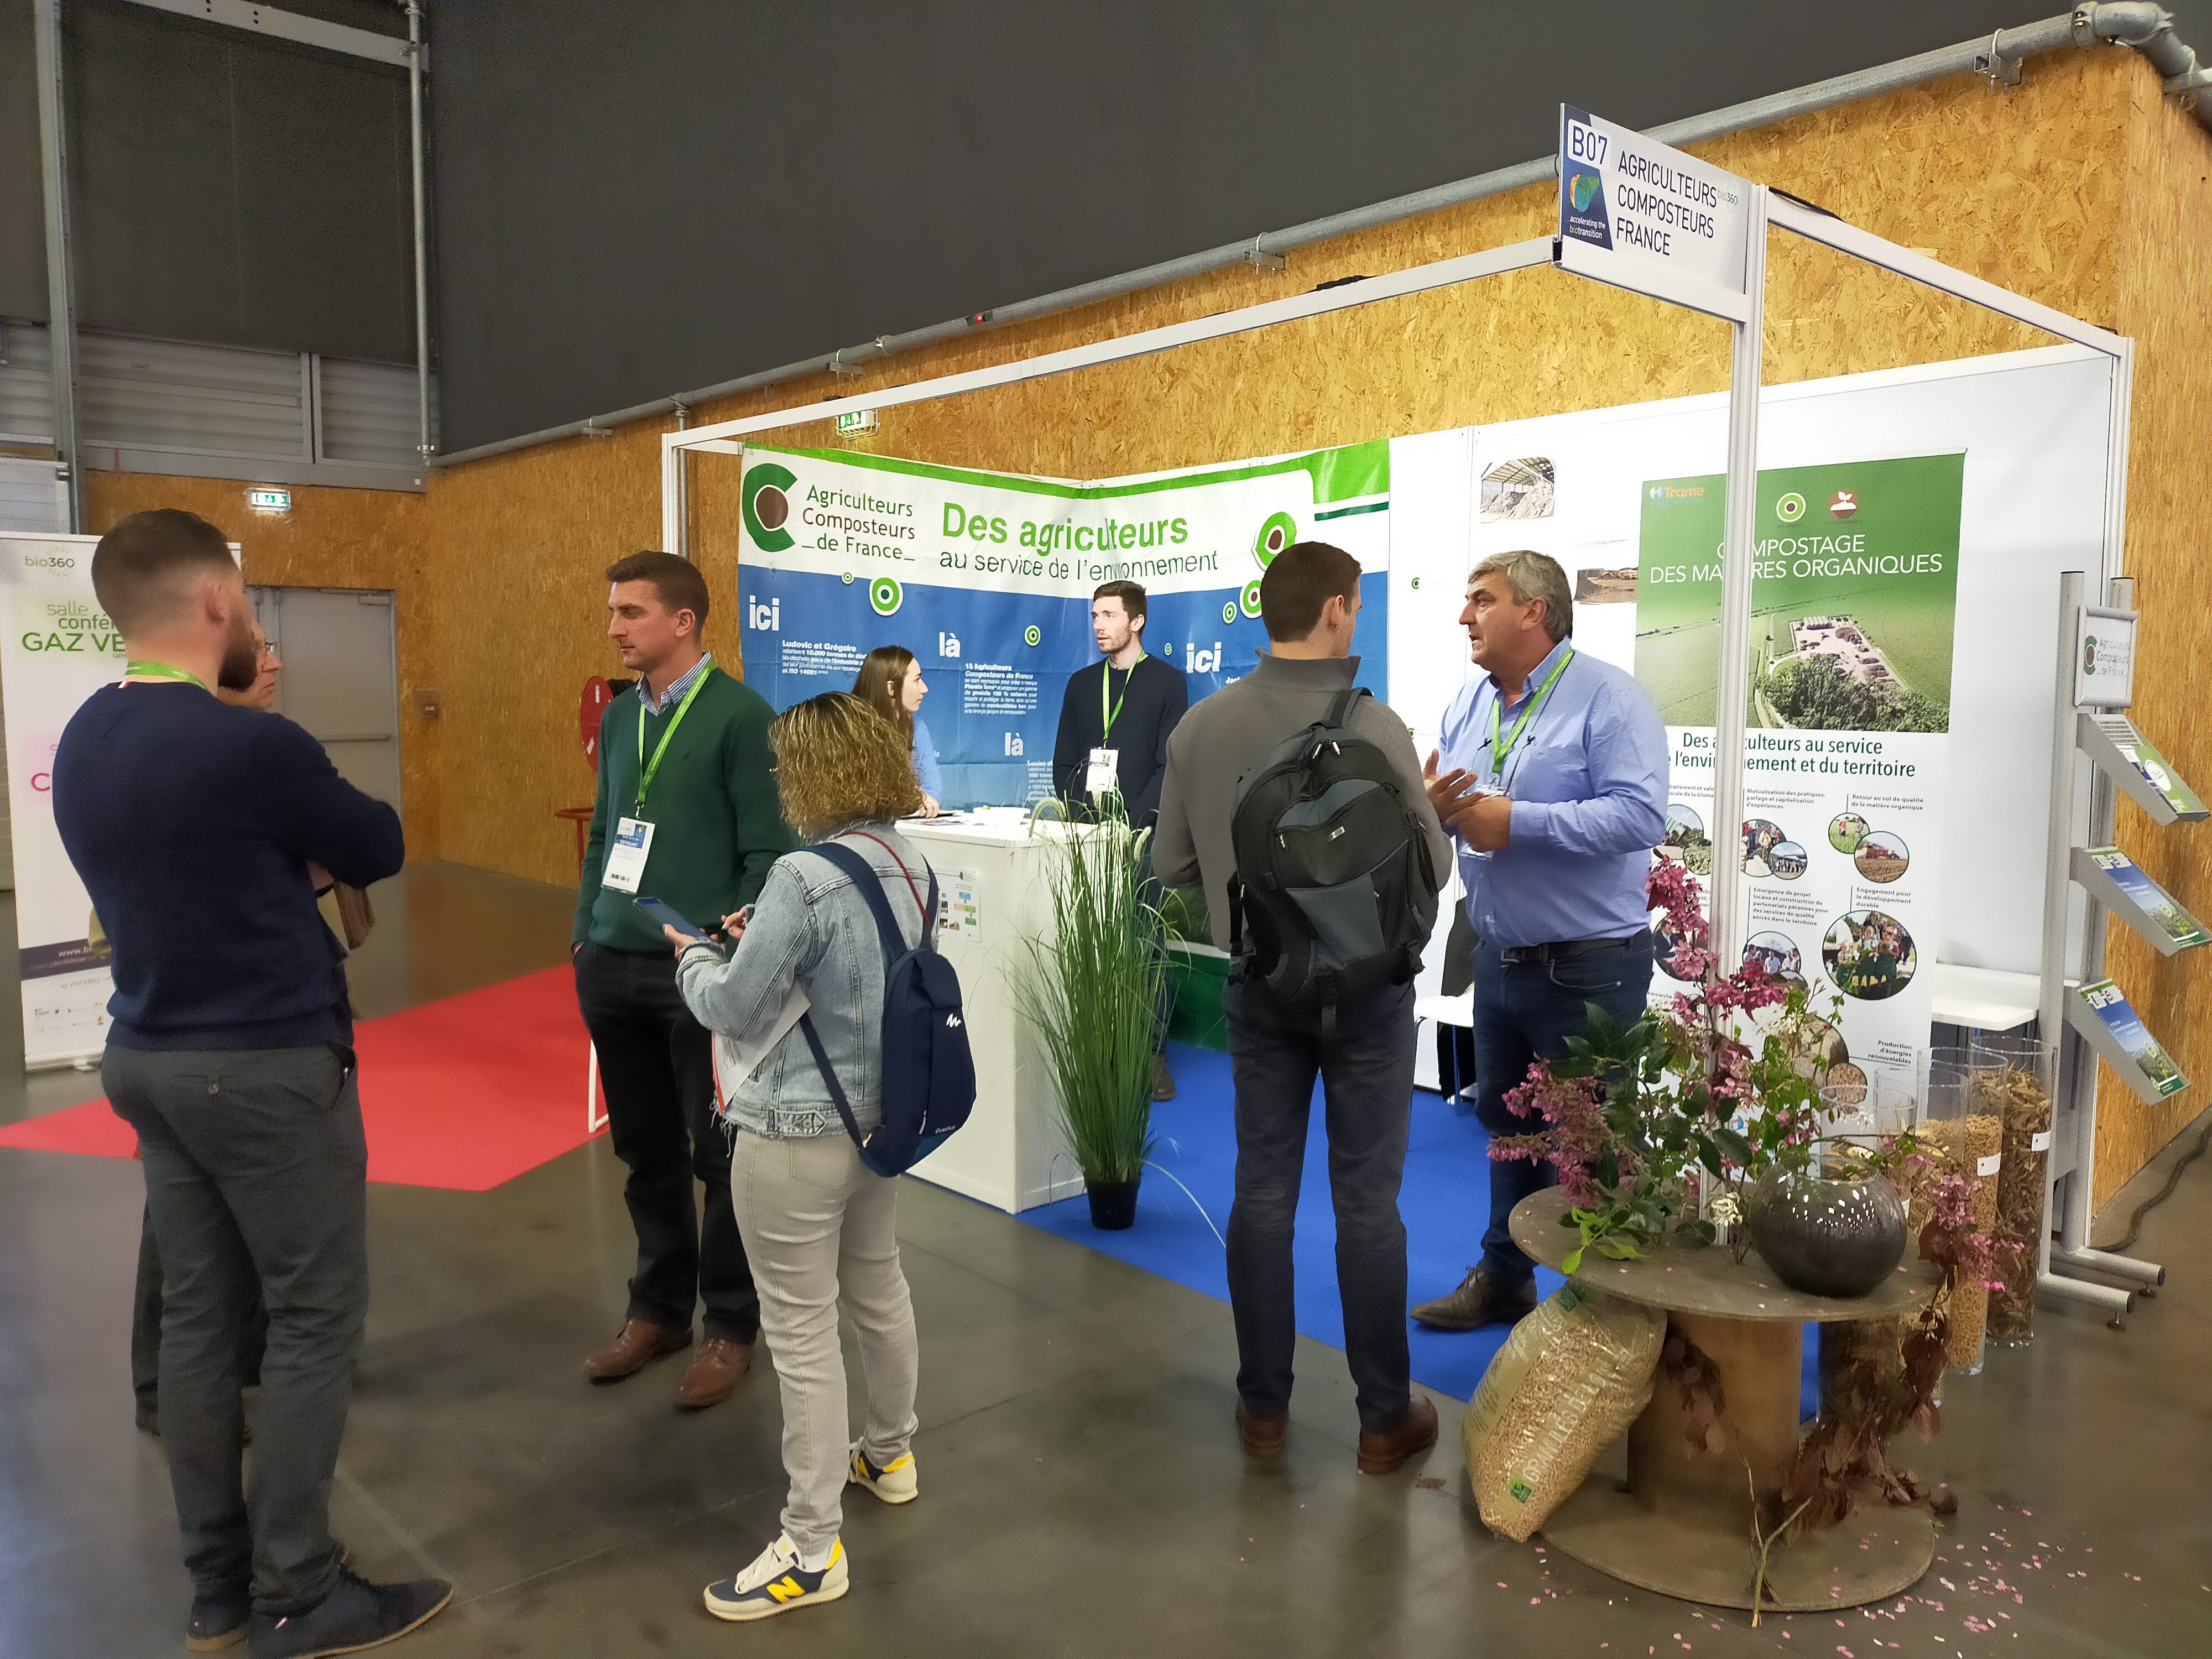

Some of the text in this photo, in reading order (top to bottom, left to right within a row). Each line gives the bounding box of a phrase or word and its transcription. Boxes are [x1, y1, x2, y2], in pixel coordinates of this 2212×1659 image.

[1573, 125, 1608, 165] B07
[1618, 150, 1717, 208] AGRICULTEURS
[1717, 187, 1738, 206] bio360
[1618, 184, 1714, 238] COMPOSTEURS
[1569, 224, 1603, 239] biotransition
[1570, 216, 1598, 229] accelerating
[1616, 217, 1671, 256] FRANCE
[806, 484, 912, 517] Agriculteurs
[1664, 486, 1705, 499] Trame
[802, 508, 915, 540] Composteurs
[943, 502, 1008, 544] Des
[1717, 534, 1865, 559] CMPOSTAGE
[25, 555, 75, 568] bio360
[940, 552, 967, 569] au
[974, 555, 1042, 577] service
[1049, 557, 1069, 579] de
[1650, 554, 1942, 583] DES MARES ORGANIQUES
[46, 601, 88, 617] salle
[749, 594, 780, 631] ici
[58, 613, 118, 630] confér
[22, 632, 126, 653] GAZ VE
[782, 640, 812, 649] Ludovic
[824, 643, 857, 652] Grégoire
[940, 632, 961, 658] là
[1186, 641, 1222, 674] ici
[1005, 732, 1023, 757] là
[1683, 732, 1709, 748] Des
[1805, 739, 1823, 752] au
[1828, 737, 1882, 754] service
[1801, 757, 1815, 772] et
[1819, 756, 1839, 774] du
[1843, 759, 1915, 777] territoire
[1856, 886, 1895, 895] Engagement
[1863, 895, 1911, 904] développement
[1878, 1040, 1912, 1050] Production
[1880, 1047, 1912, 1057] d'énergies
